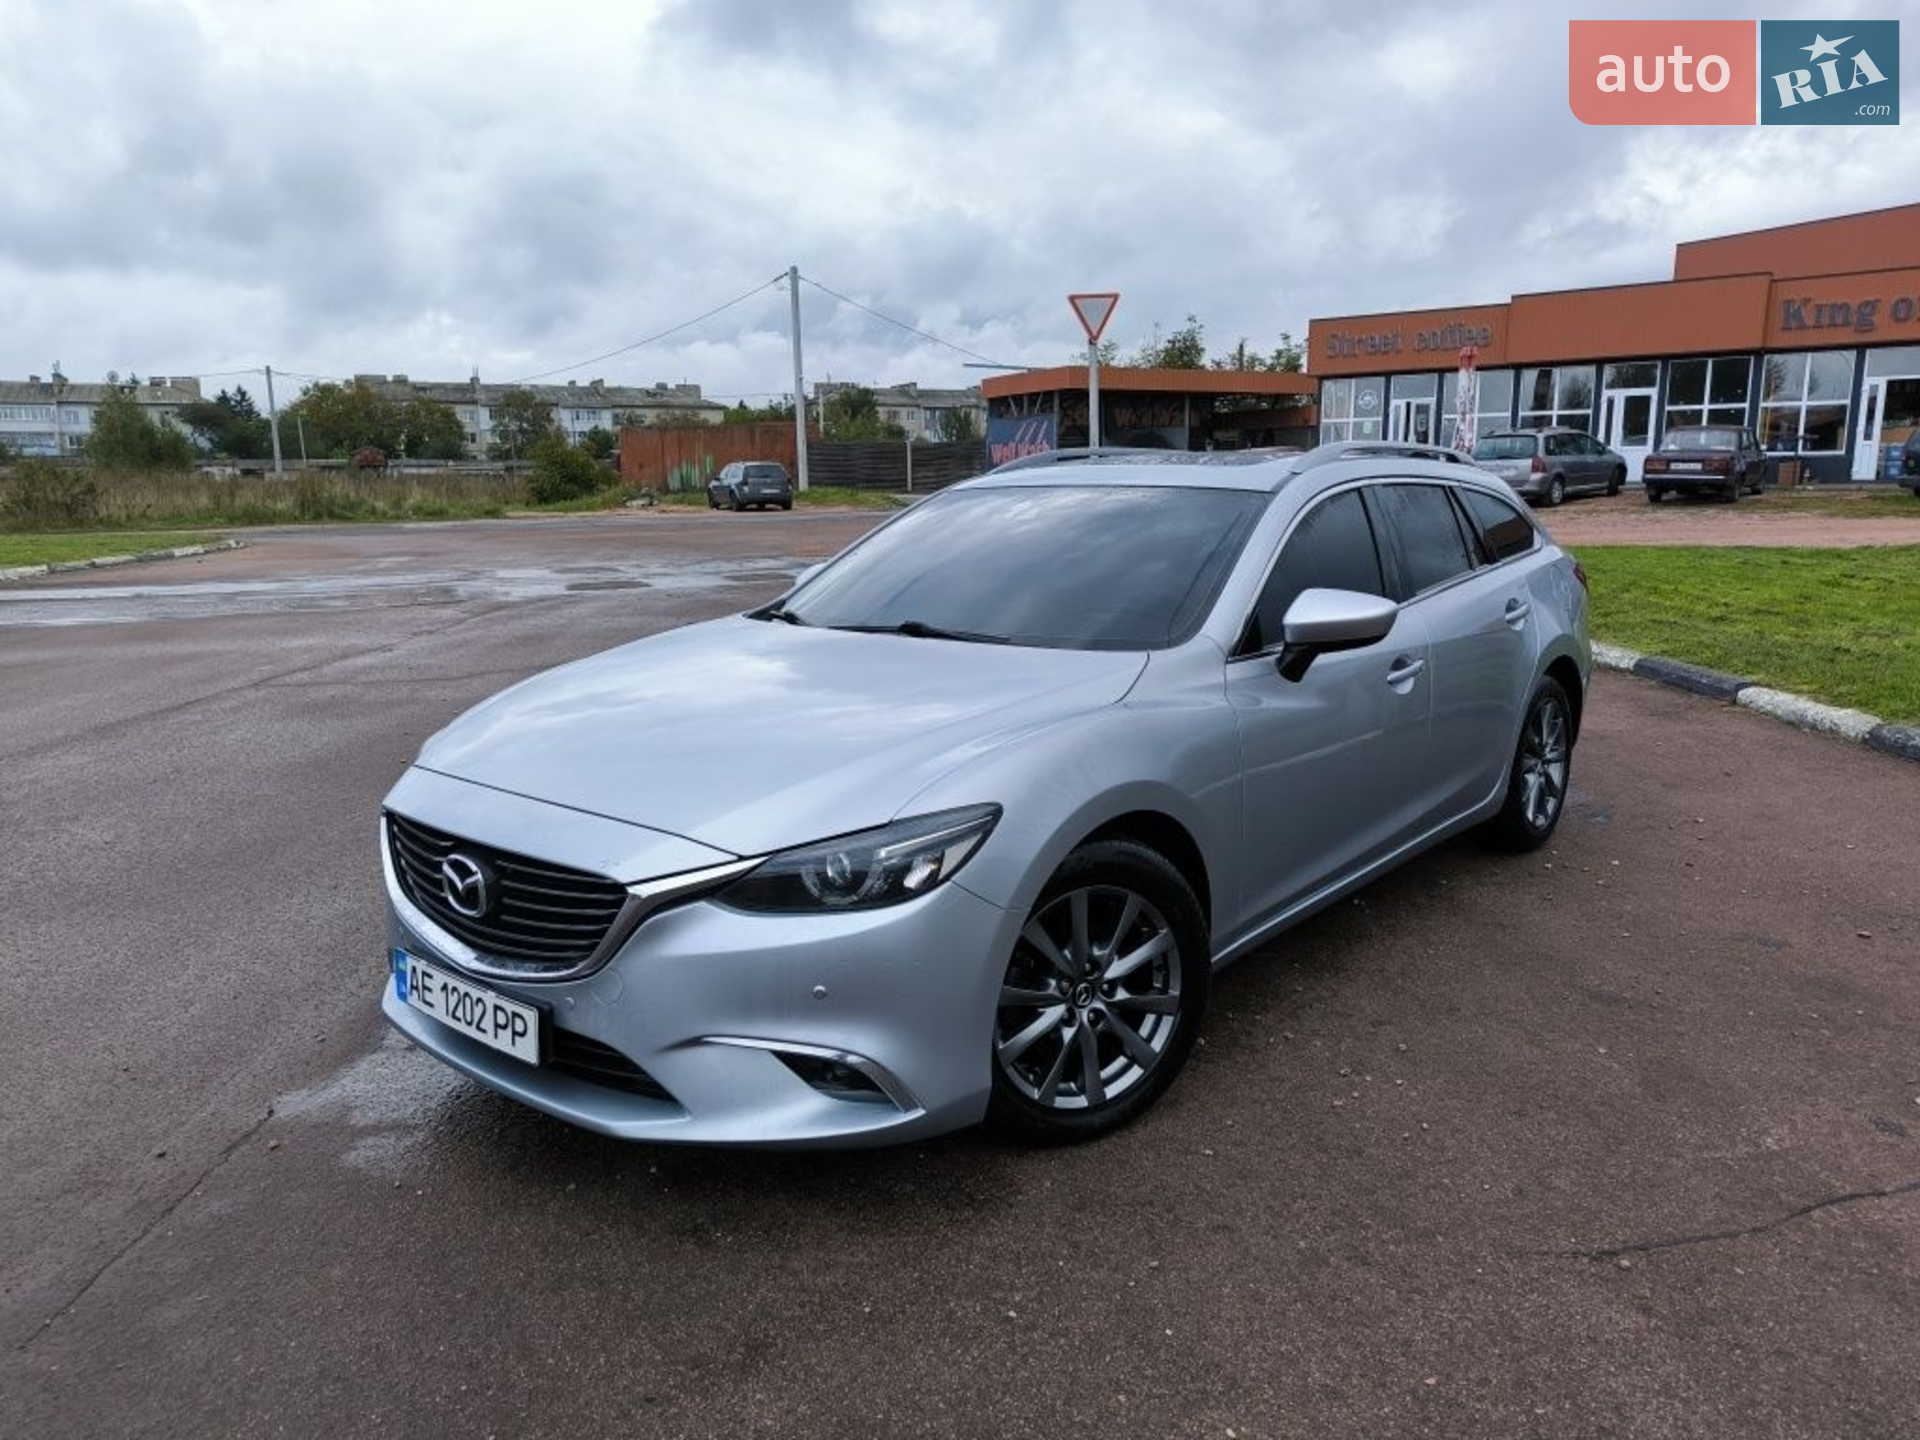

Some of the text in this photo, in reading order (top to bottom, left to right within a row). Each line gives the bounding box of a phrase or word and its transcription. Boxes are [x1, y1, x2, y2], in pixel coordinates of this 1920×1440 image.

[1781, 297, 1880, 333] King
[1326, 321, 1492, 359] Street coffee
[410, 965, 529, 1047] AE 1202 PP
